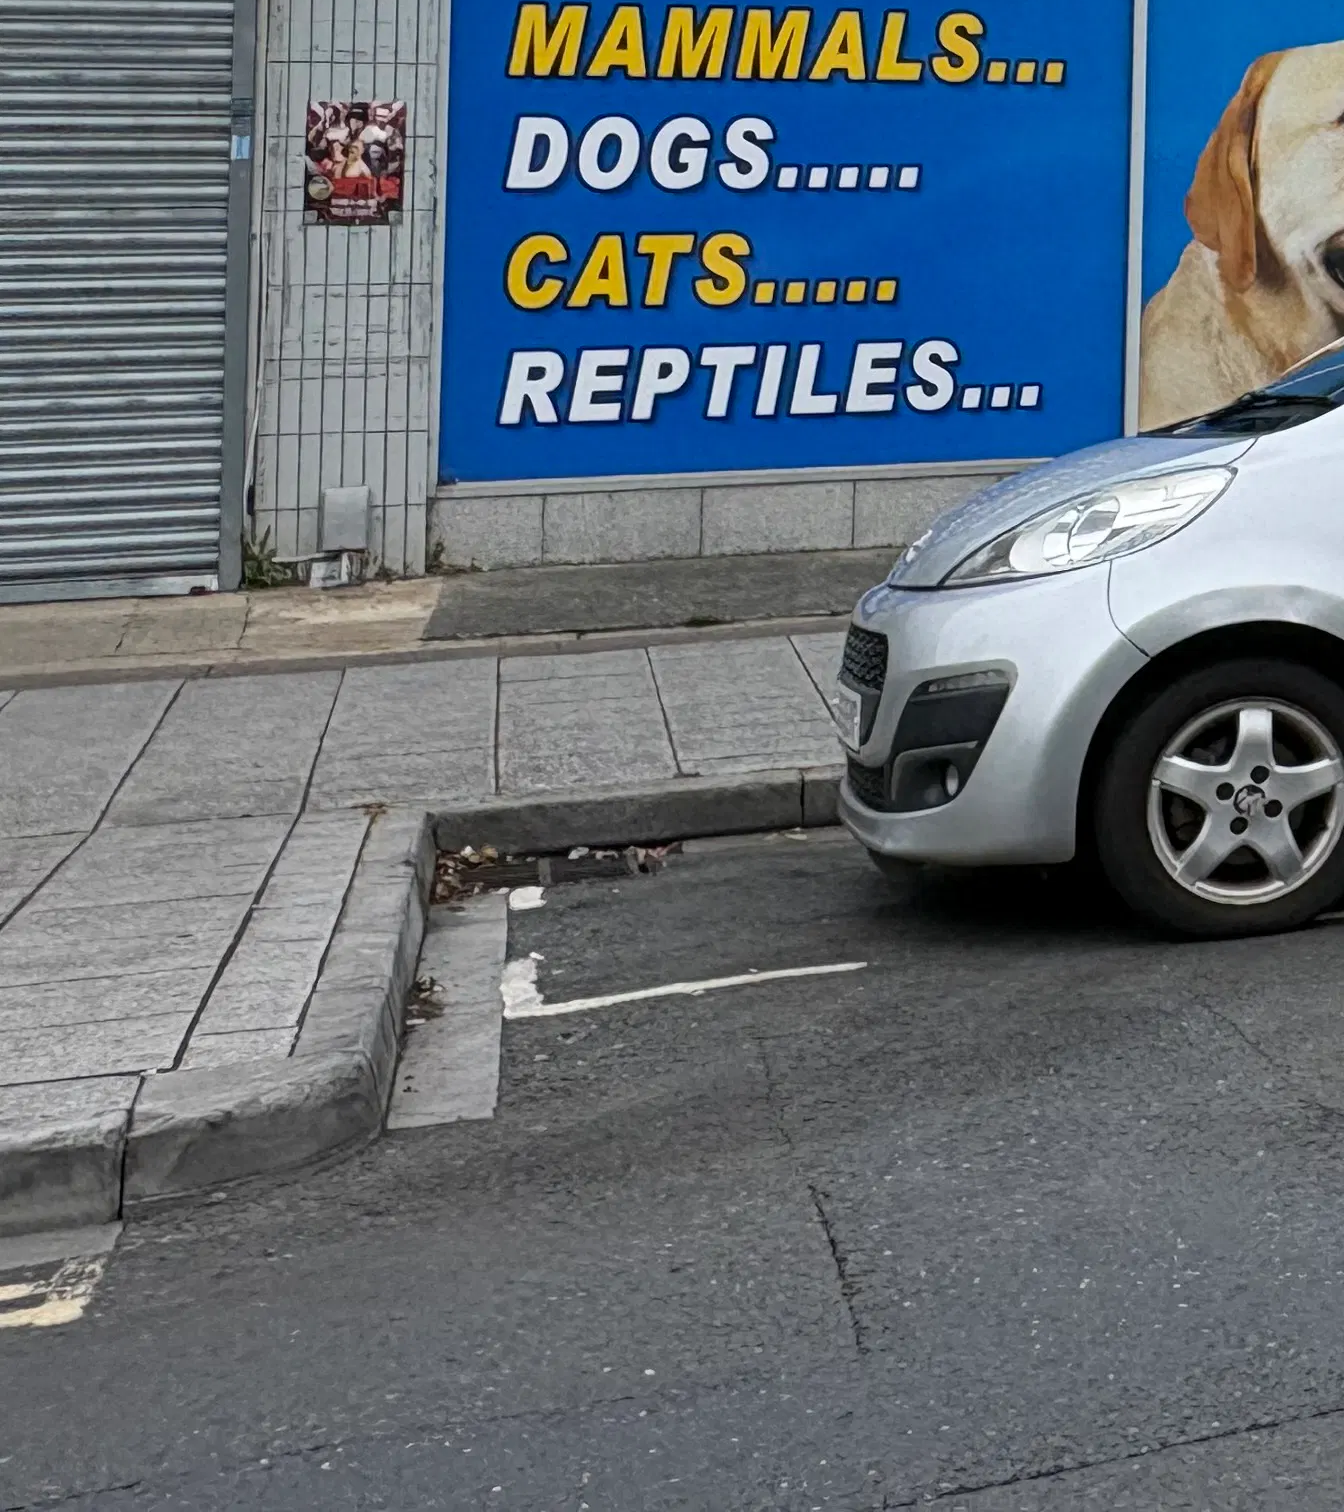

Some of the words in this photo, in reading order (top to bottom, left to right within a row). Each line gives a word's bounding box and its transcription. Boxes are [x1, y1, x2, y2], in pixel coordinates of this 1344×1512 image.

[506, 2, 1066, 83] MAMMALS...
[502, 114, 922, 190] DOGS.....
[504, 232, 898, 309] CATS.....
[498, 339, 1041, 425] REPTILES...
